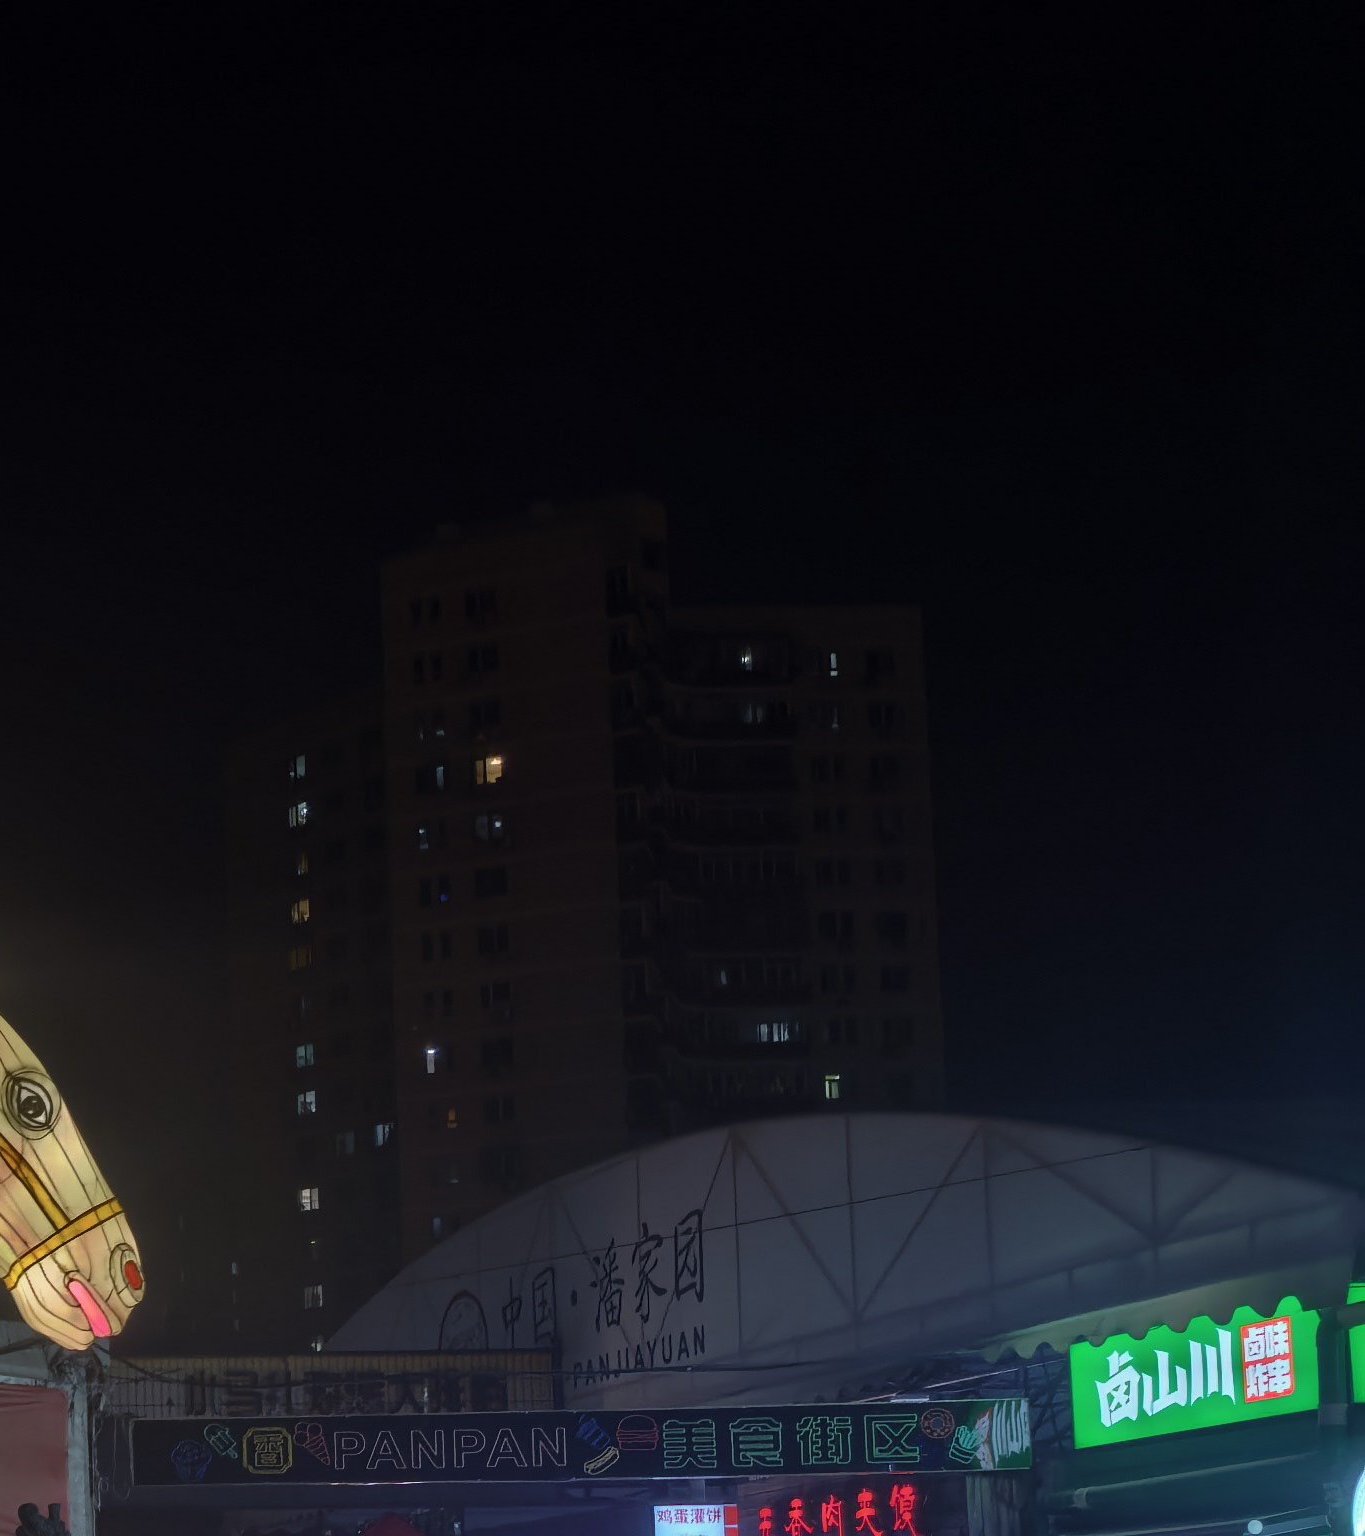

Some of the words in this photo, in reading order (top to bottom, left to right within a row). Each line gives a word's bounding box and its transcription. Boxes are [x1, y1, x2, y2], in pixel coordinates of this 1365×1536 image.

[573, 1325, 705, 1388] PANJIAYUAN
[1244, 1321, 1290, 1362] 卤味
[1095, 1328, 1236, 1427] 卤山川
[1245, 1358, 1292, 1398] 炸串
[334, 1427, 567, 1470] PANPAN
[661, 1413, 920, 1469] 美食街区
[656, 1507, 723, 1524] 鸡蛋灌饼
